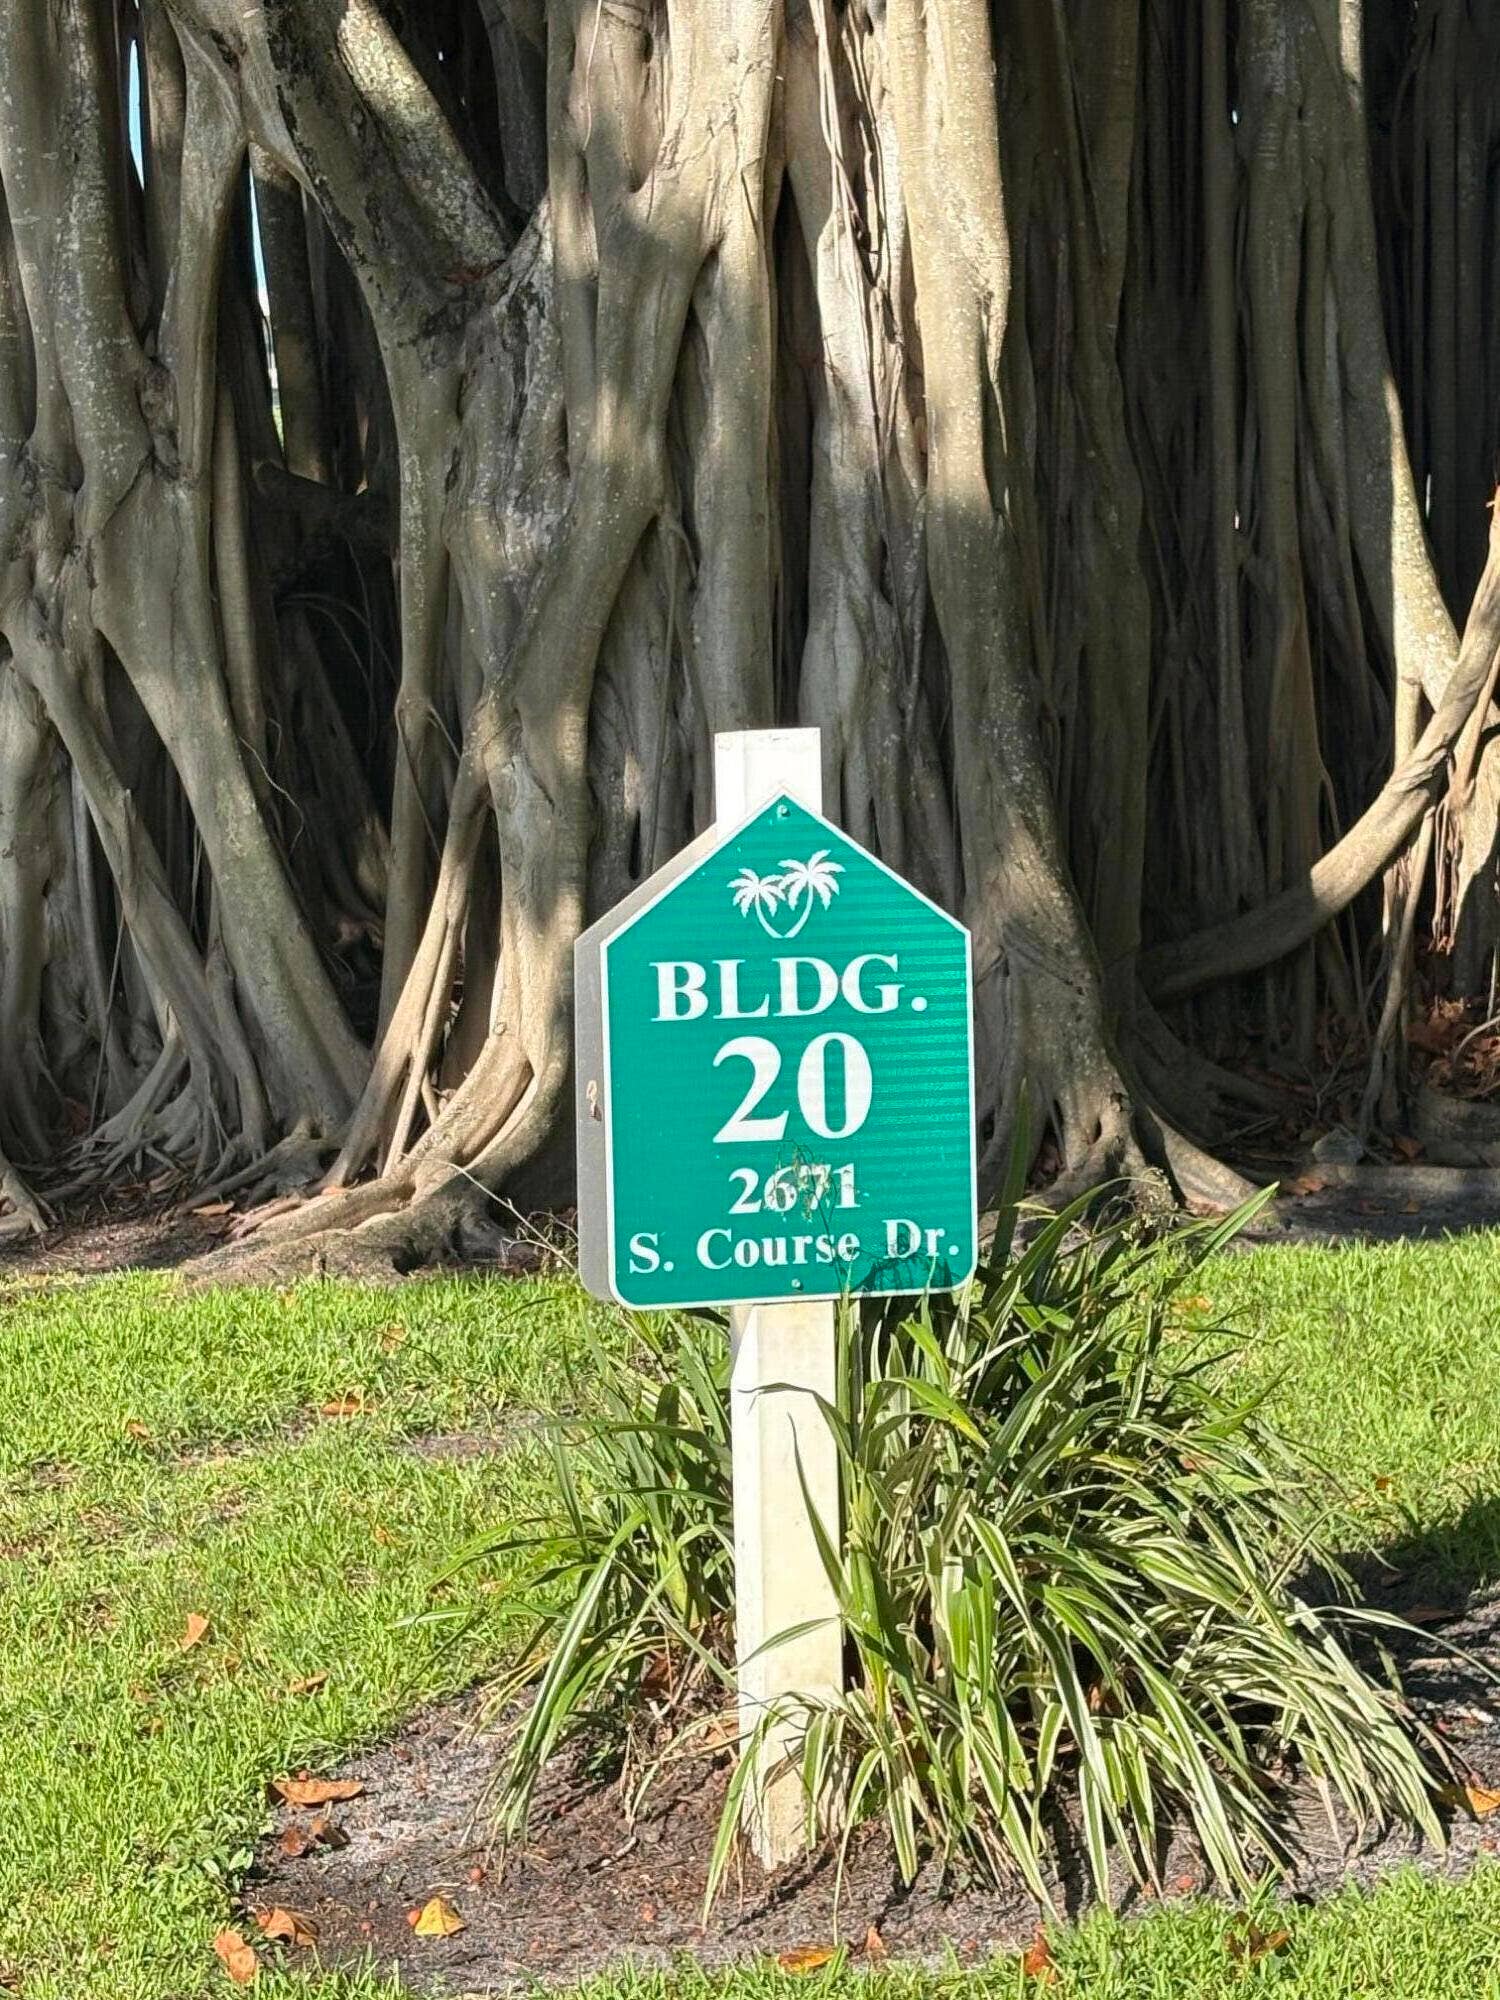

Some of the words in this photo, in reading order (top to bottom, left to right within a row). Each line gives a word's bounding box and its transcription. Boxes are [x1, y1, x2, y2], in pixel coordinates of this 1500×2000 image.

[649, 953, 928, 1022] BLDG.
[712, 1032, 873, 1143] 20
[728, 1163, 861, 1214] 2671
[629, 1232, 674, 1274] S.
[696, 1228, 860, 1270] Course
[882, 1218, 959, 1260] Dr.
